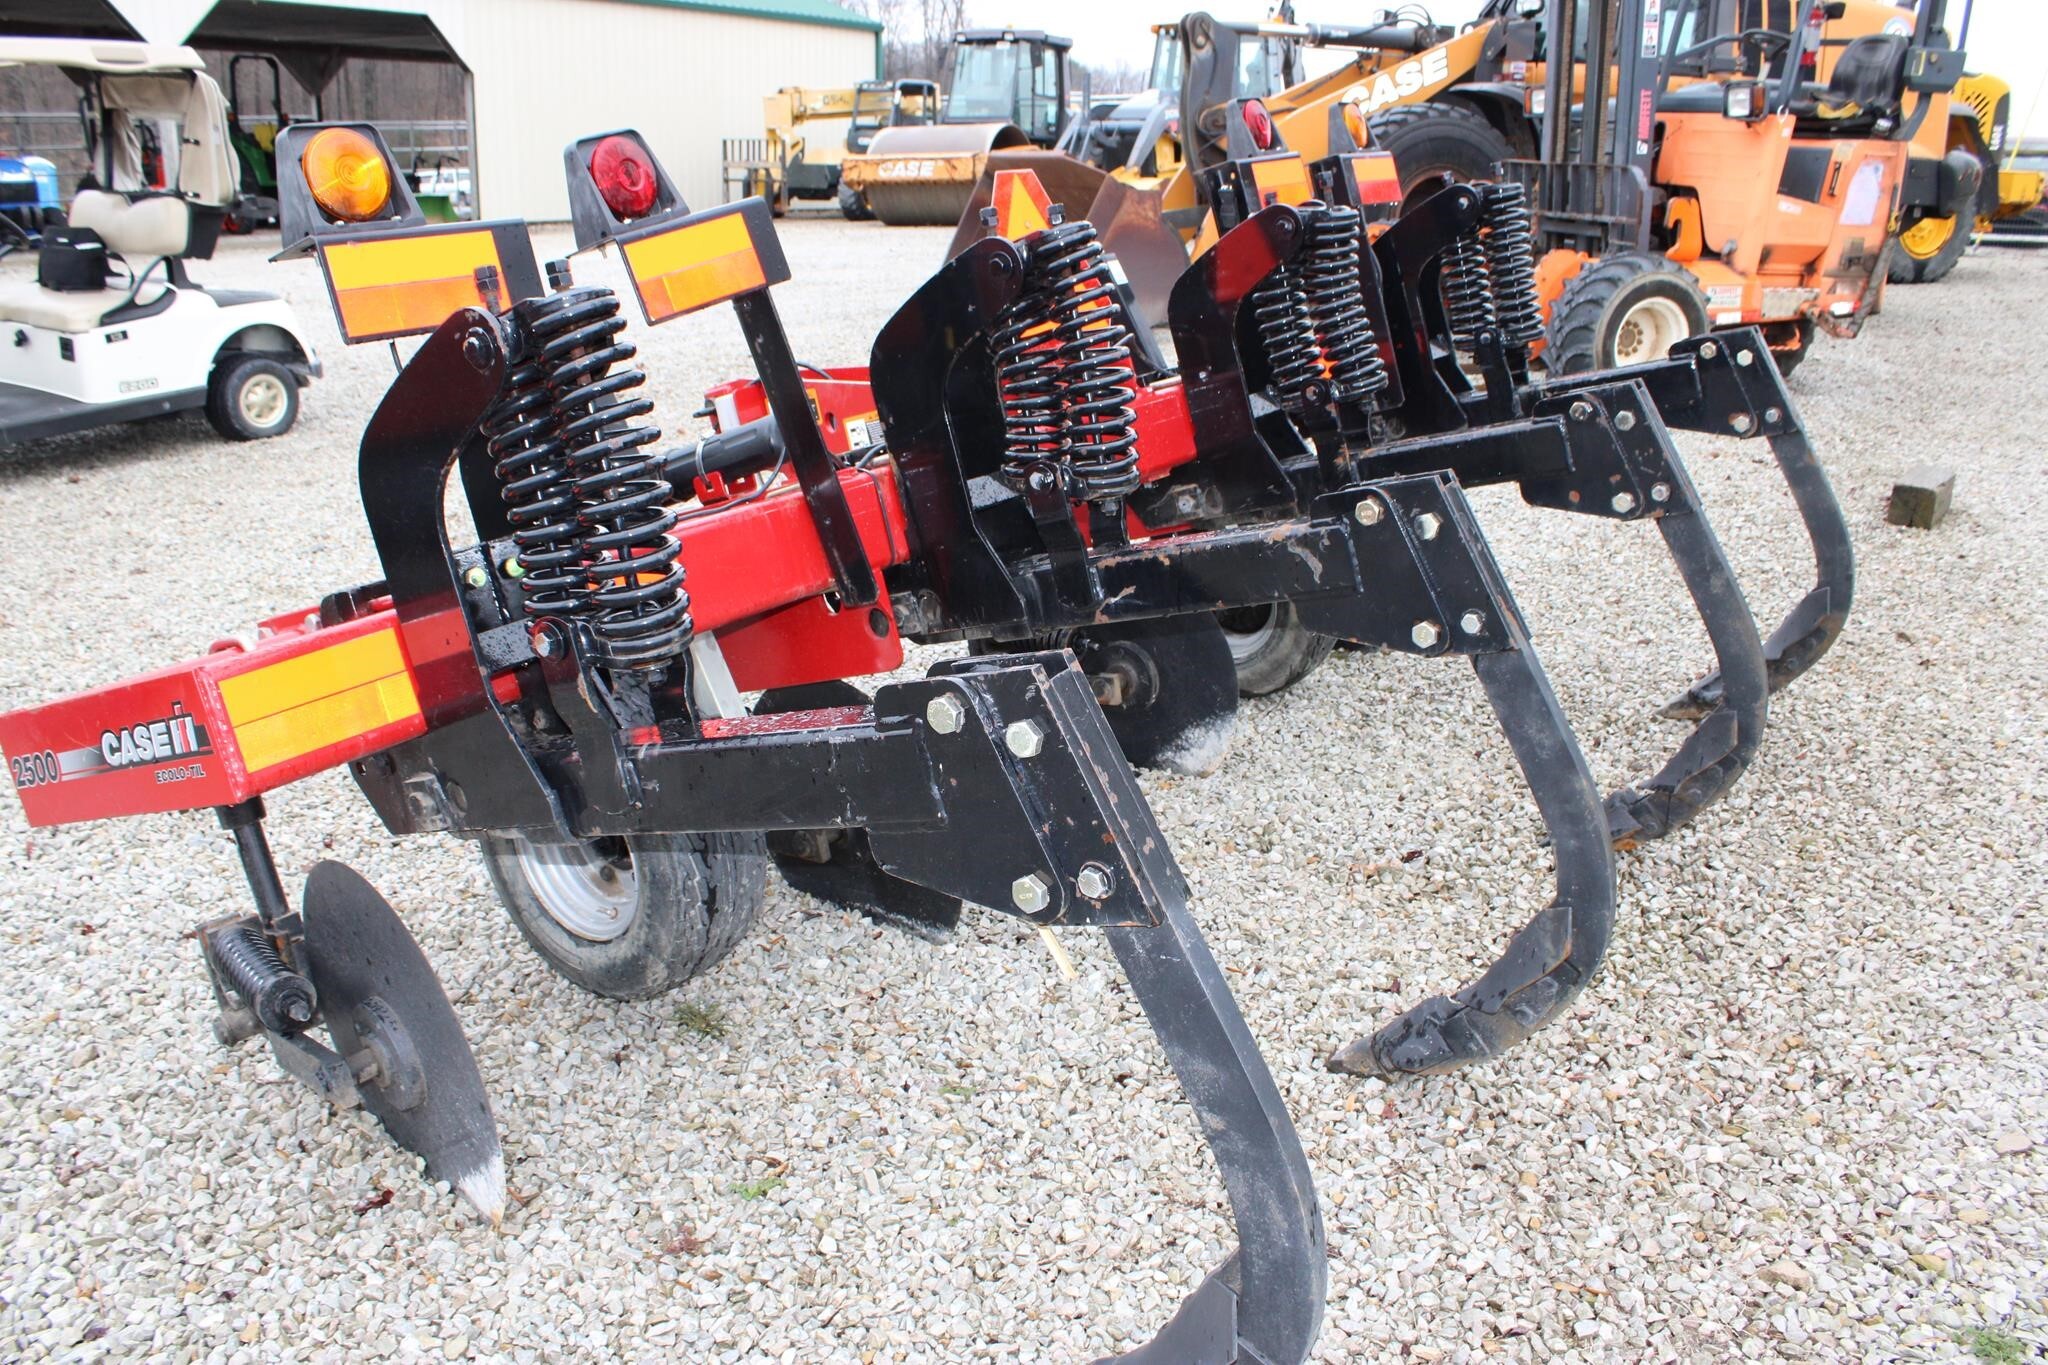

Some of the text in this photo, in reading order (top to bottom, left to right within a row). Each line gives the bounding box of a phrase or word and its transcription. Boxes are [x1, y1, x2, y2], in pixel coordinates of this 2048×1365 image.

[1342, 47, 1449, 115] CASE
[1637, 89, 1652, 140] MOFFETT
[878, 160, 936, 177] CASE
[12, 750, 60, 789] 2500
[155, 764, 206, 783] ECOLO-TIL
